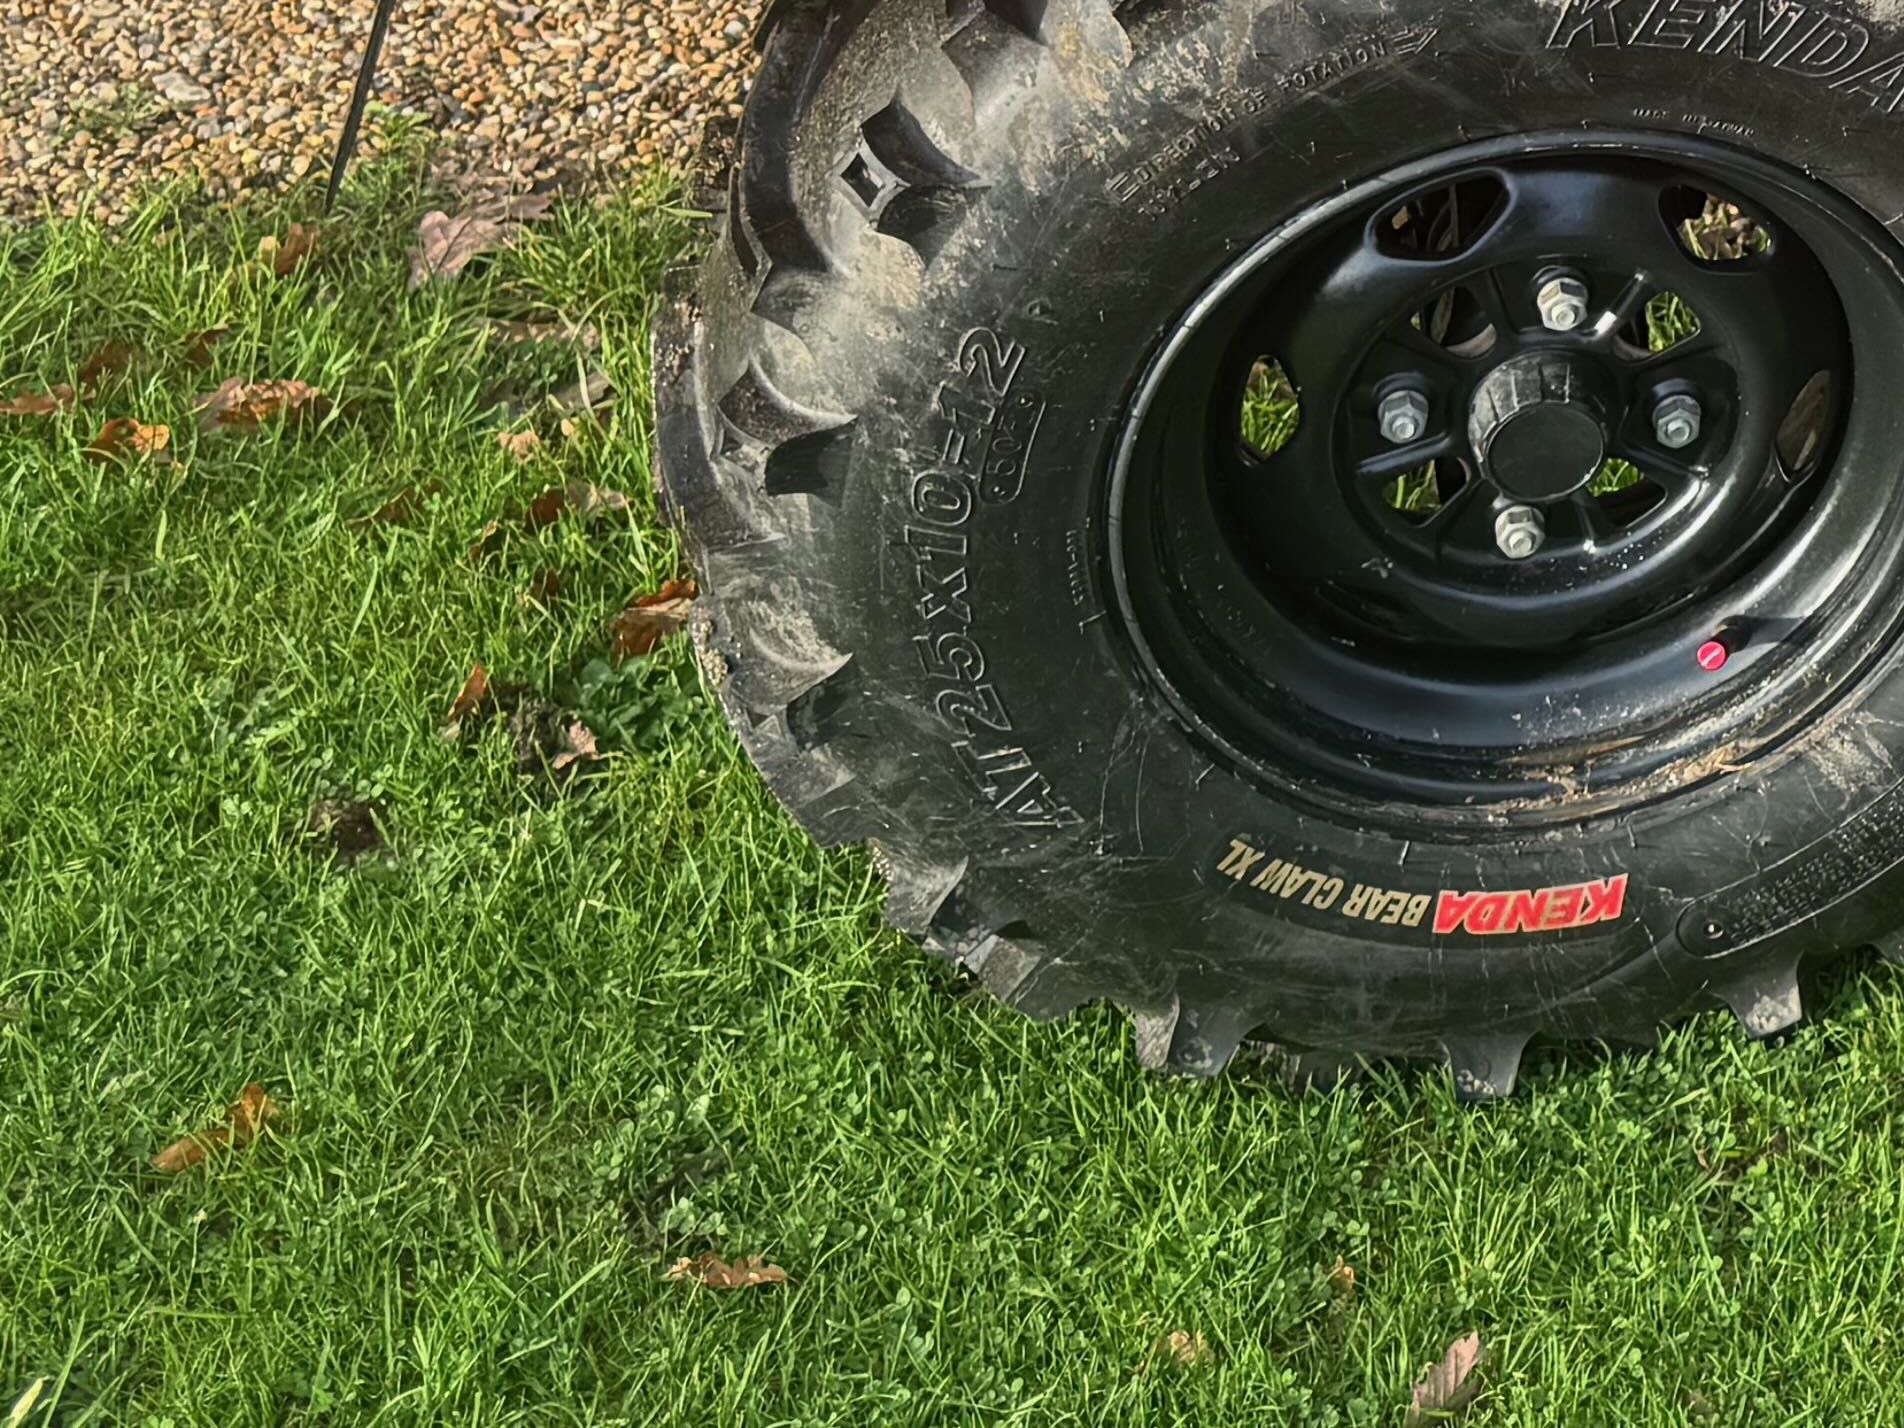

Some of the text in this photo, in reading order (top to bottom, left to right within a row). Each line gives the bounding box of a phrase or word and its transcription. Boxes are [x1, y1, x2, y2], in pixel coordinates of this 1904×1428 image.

[1216, 838, 1630, 935] KENDA BEAR CLAW XL
